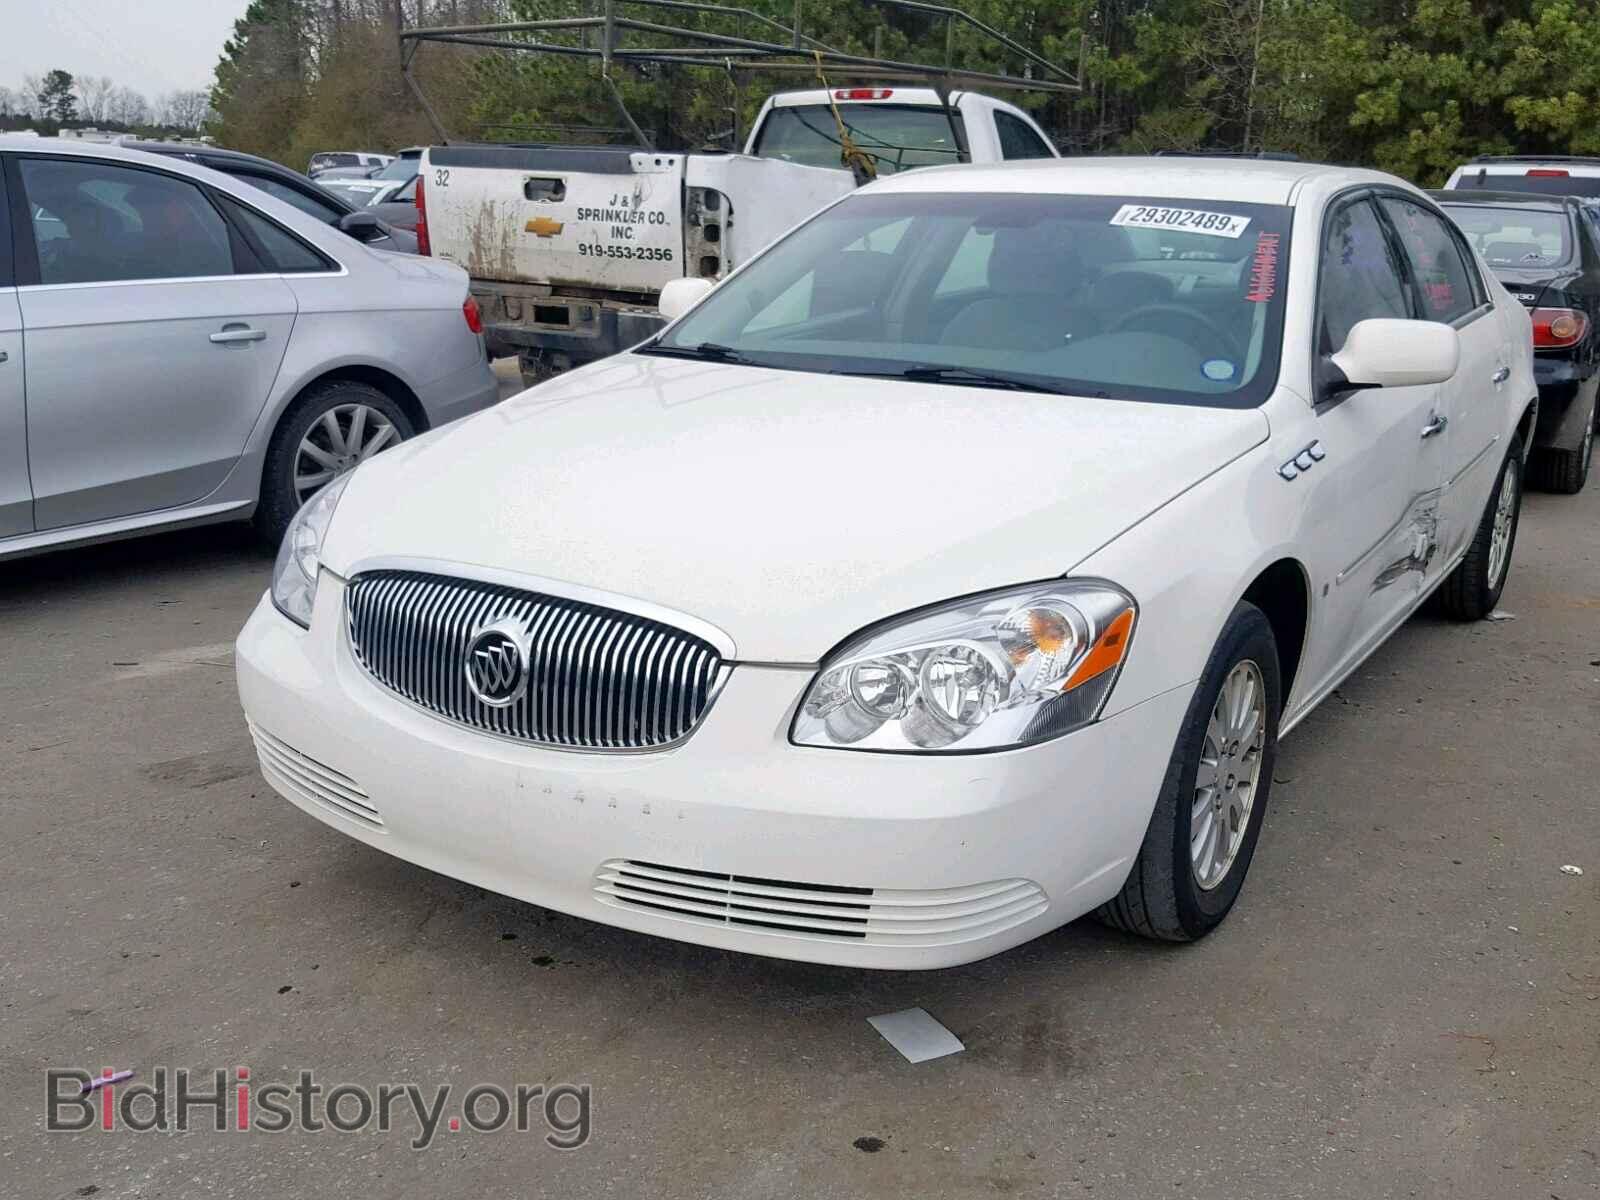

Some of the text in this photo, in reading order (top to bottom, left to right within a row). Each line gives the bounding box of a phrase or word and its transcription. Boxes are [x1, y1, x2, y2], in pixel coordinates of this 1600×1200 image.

[435, 169, 450, 188] 32
[609, 193, 618, 207] J
[621, 195, 629, 208] &
[577, 207, 646, 225] SPRINKLER
[578, 243, 673, 261] 919-553-2356
